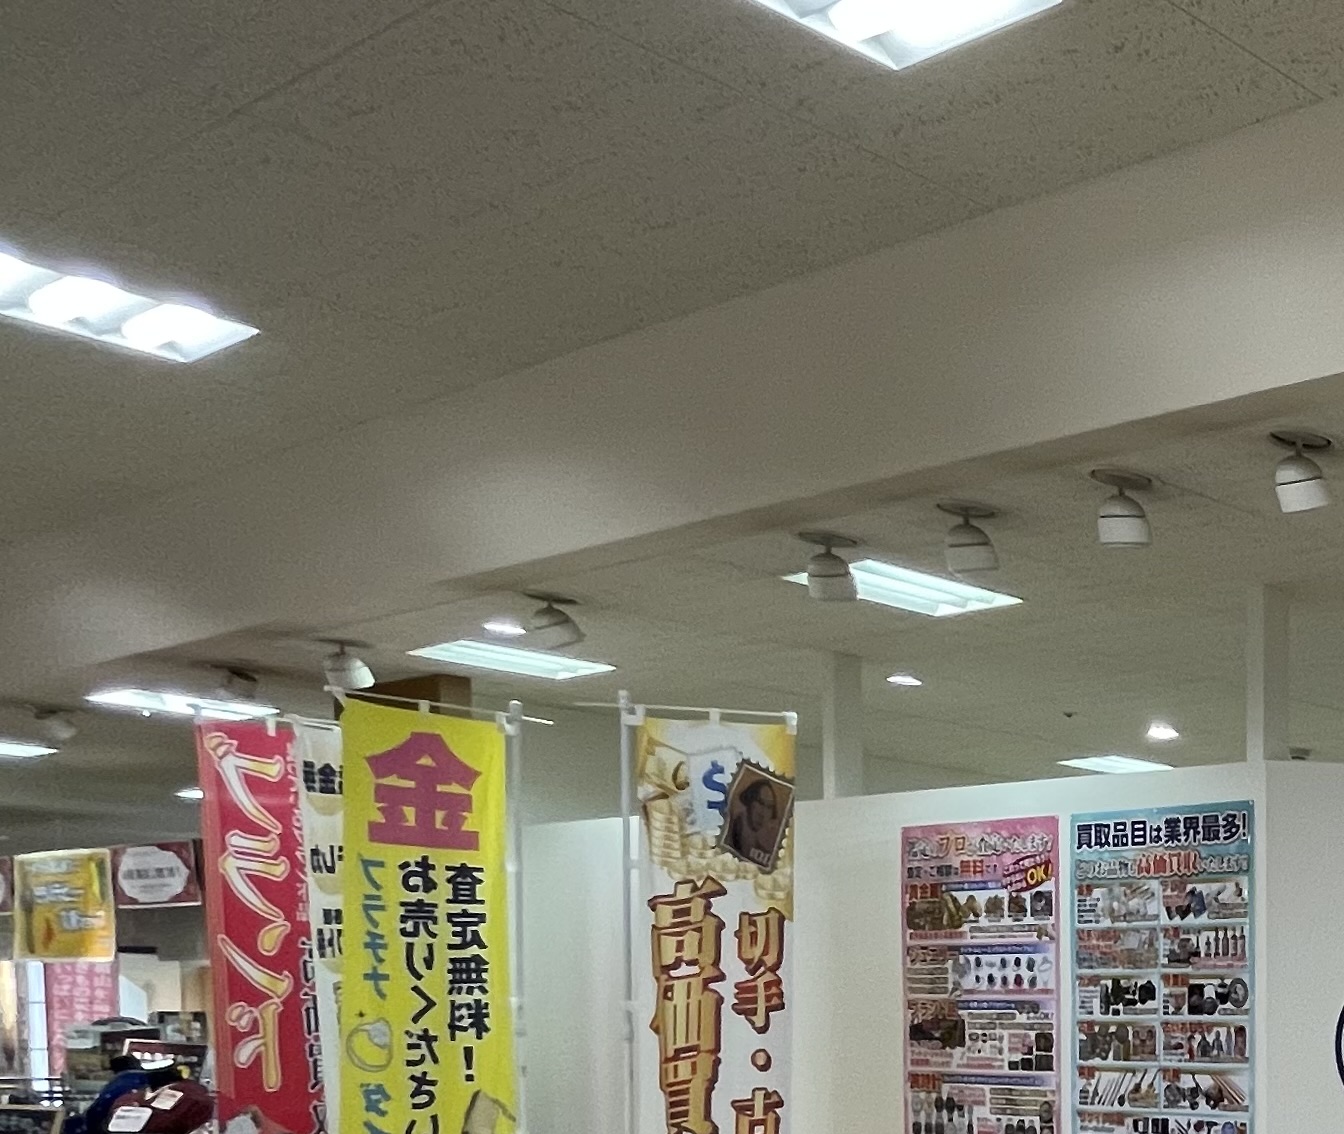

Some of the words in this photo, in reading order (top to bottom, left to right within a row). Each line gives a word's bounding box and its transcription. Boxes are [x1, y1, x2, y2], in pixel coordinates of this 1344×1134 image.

[1076, 811, 1248, 850] 買取品目は業界最多!
